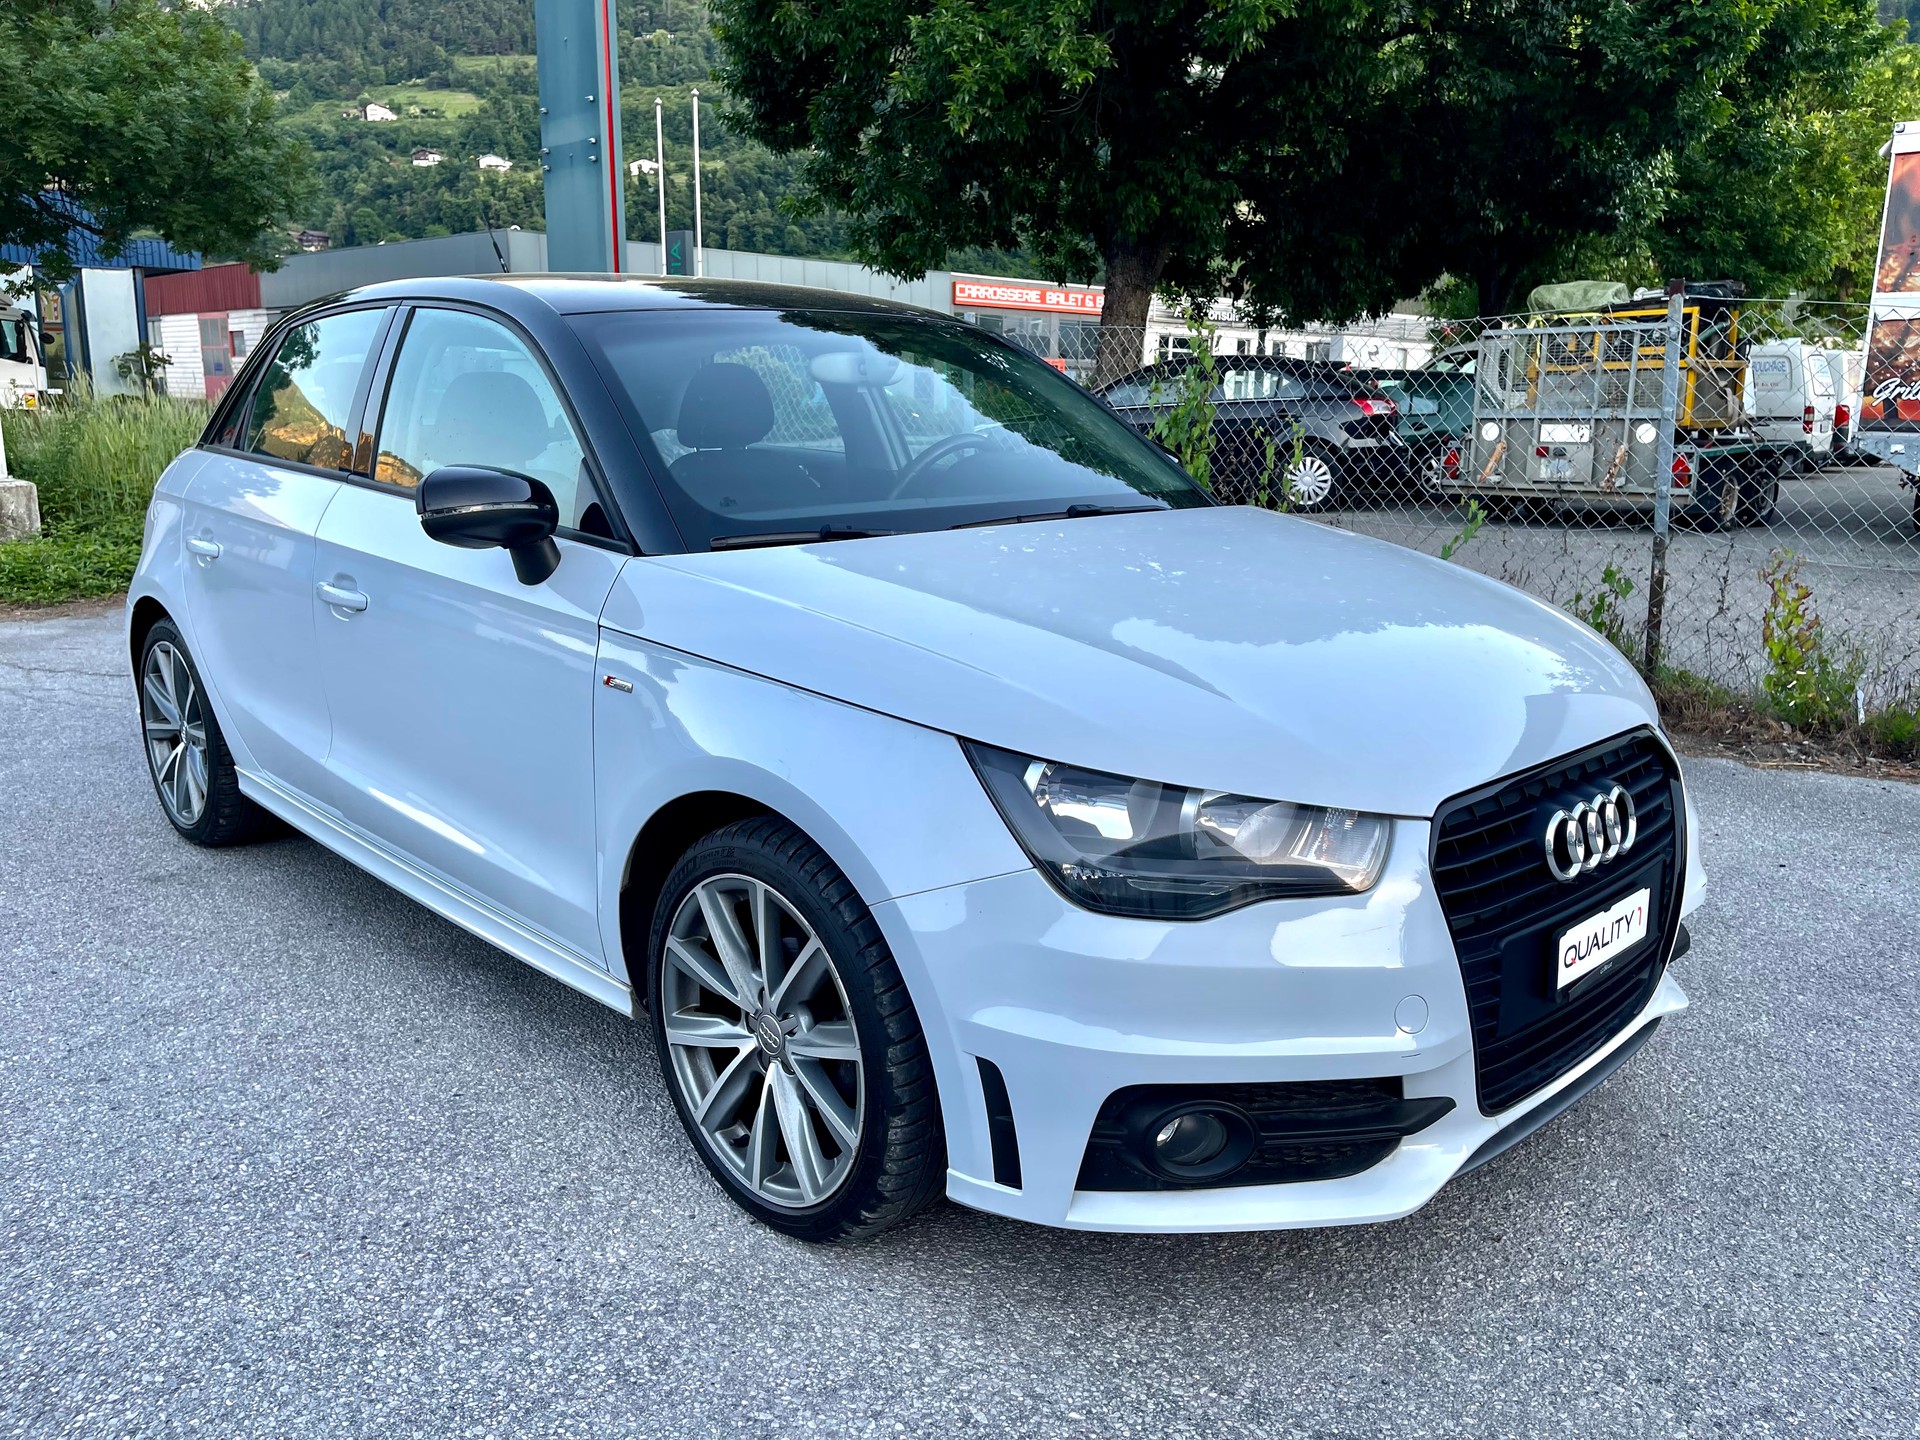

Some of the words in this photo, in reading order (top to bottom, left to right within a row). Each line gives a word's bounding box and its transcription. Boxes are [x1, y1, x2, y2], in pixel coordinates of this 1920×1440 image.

[955, 284, 1041, 303] CARROSSERIE
[1046, 292, 1083, 306] BALET
[1085, 295, 1094, 307] &
